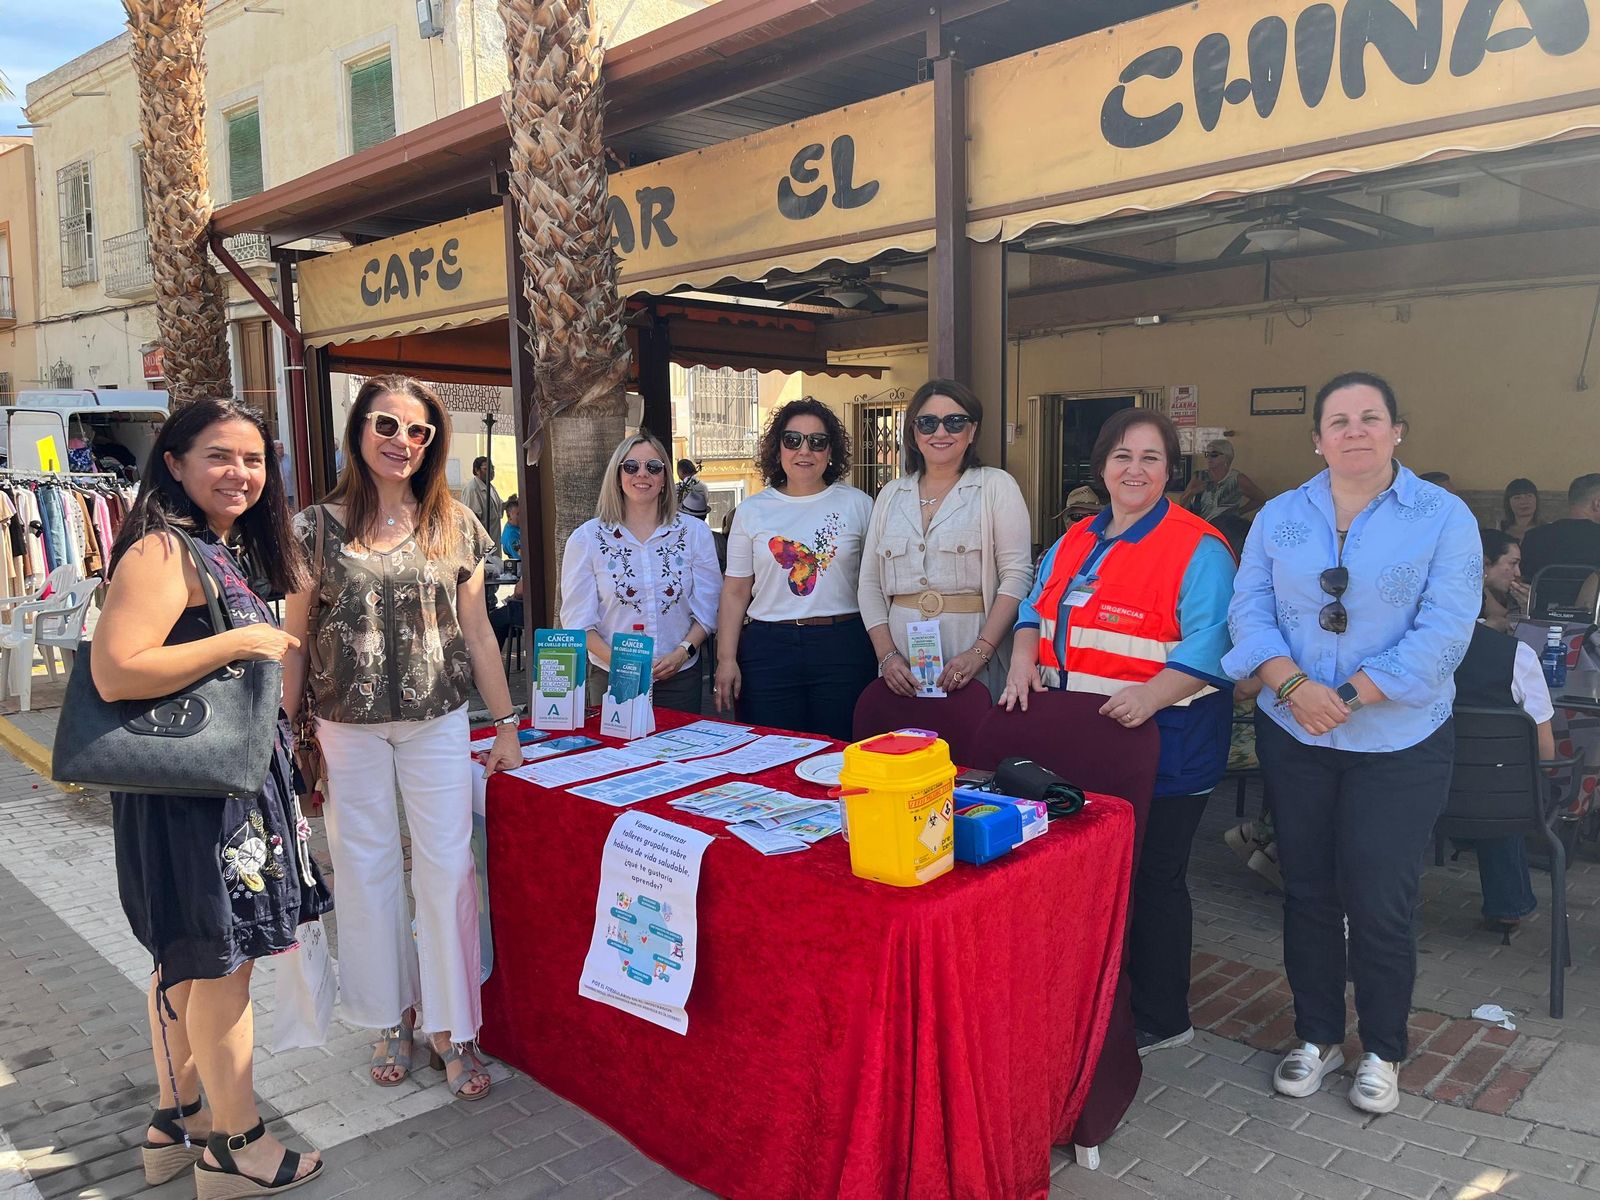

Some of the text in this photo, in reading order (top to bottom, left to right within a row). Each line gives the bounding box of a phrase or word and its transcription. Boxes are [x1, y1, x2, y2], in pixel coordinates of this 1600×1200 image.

[360, 0, 1590, 307] CAFE AR EL CHINA
[1101, 604, 1144, 619] URGENCIAS
[622, 829, 687, 860] talleres grupales sobre
[634, 819, 652, 832] Vamos
[658, 829, 687, 845] comenzar
[635, 847, 642, 857] de
[644, 853, 657, 863] vida
[658, 859, 690, 877] saludable,
[640, 864, 646, 872] te
[631, 875, 663, 892] aprender?
